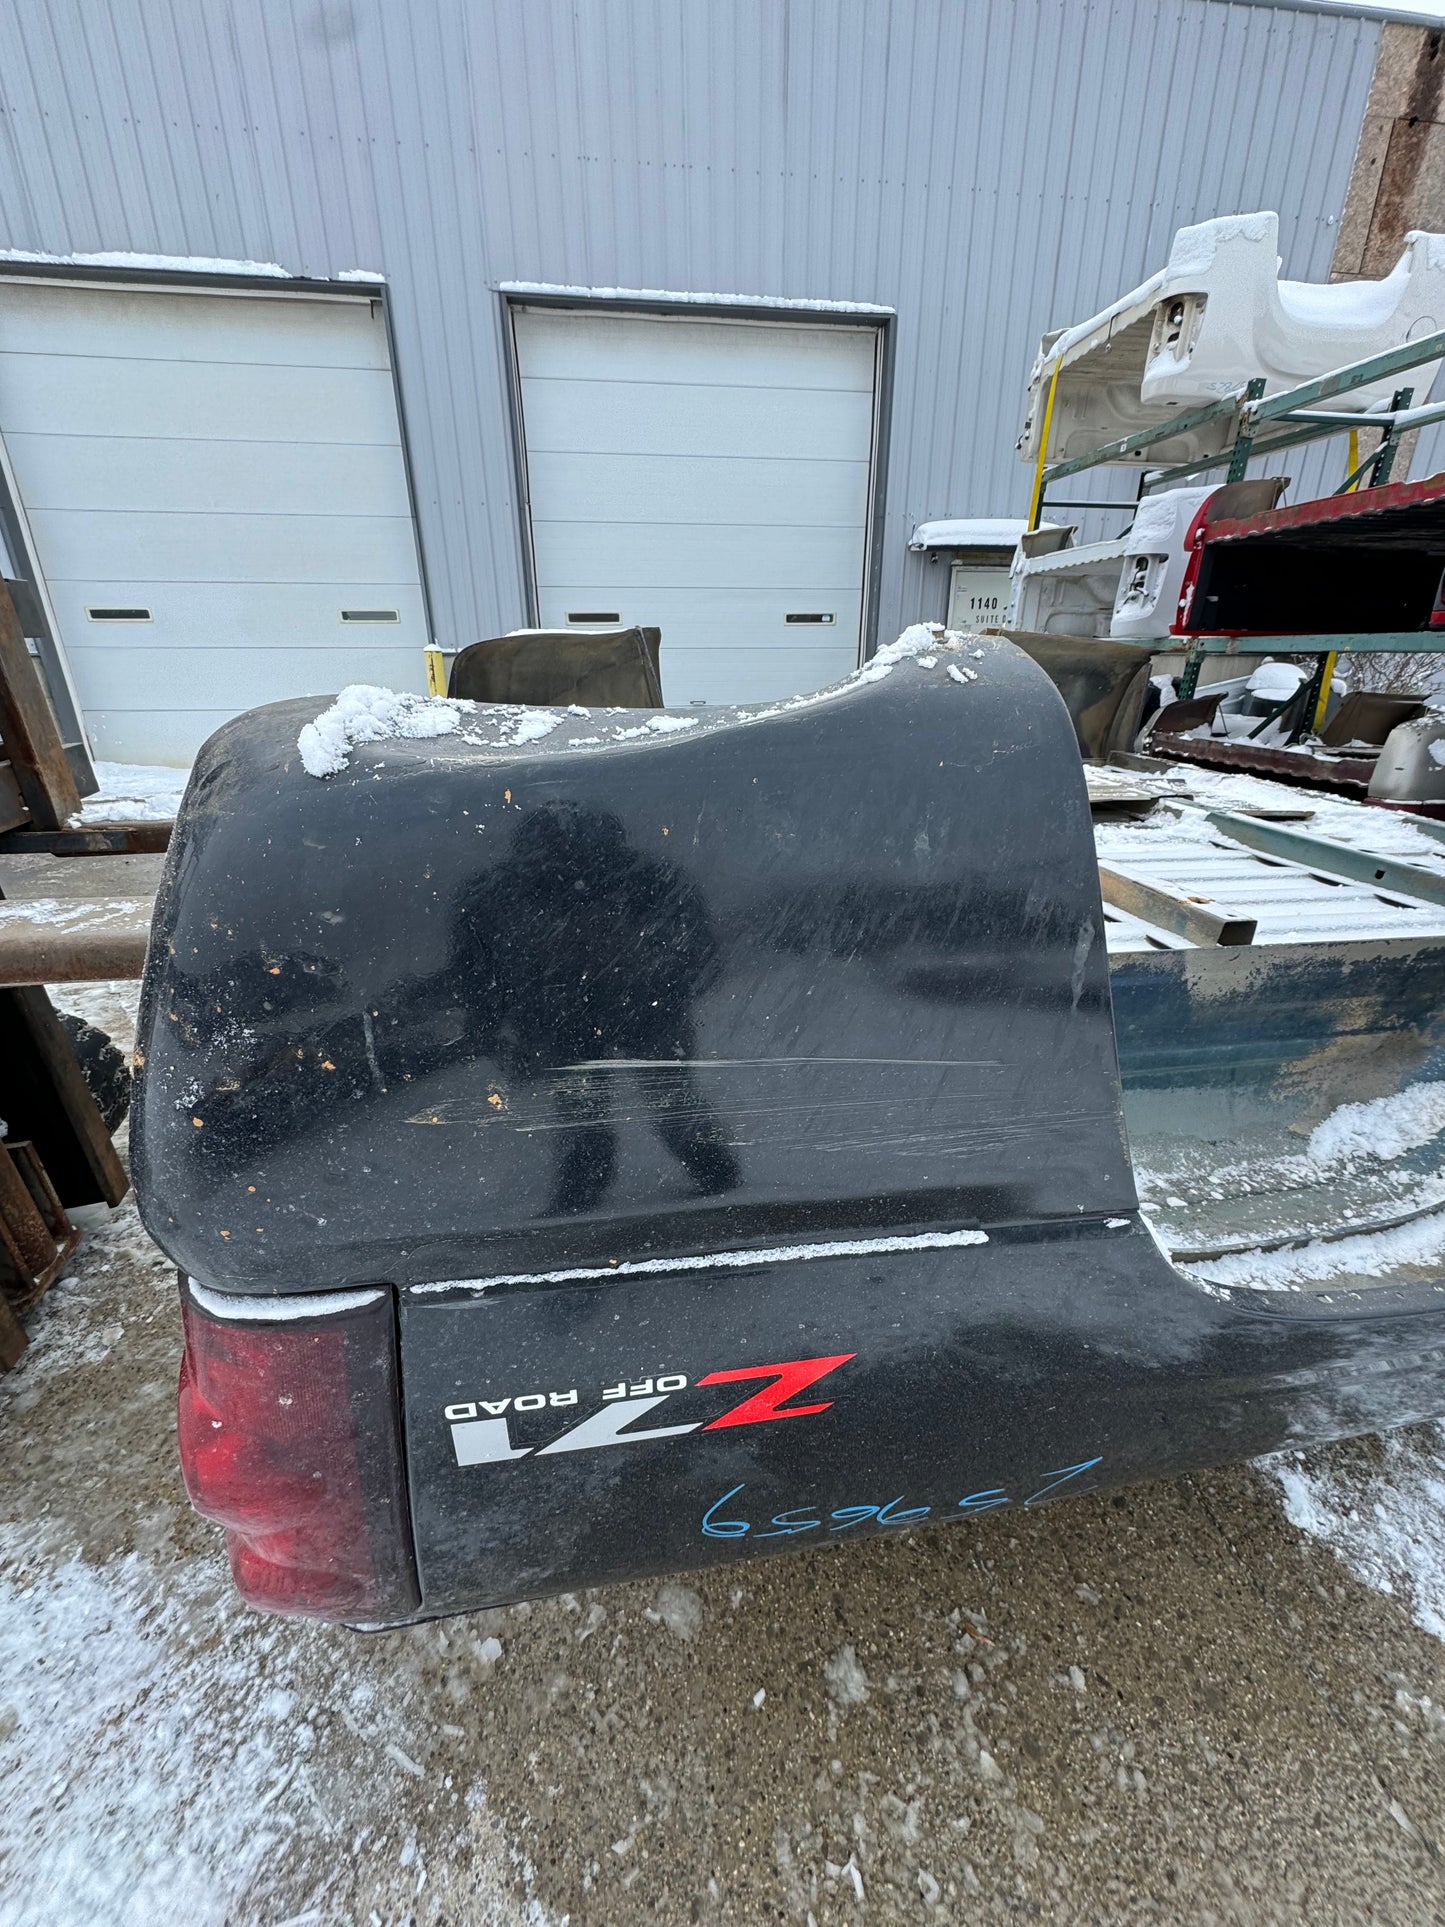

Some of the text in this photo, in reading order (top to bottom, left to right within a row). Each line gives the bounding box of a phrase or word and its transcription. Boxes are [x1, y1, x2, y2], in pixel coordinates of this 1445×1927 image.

[970, 597, 998, 610] 1140
[975, 615, 999, 623] SUITE
[444, 1374, 689, 1420] OFF ROAD
[450, 1353, 858, 1467] Z71
[701, 1456, 1104, 1538] 259659
